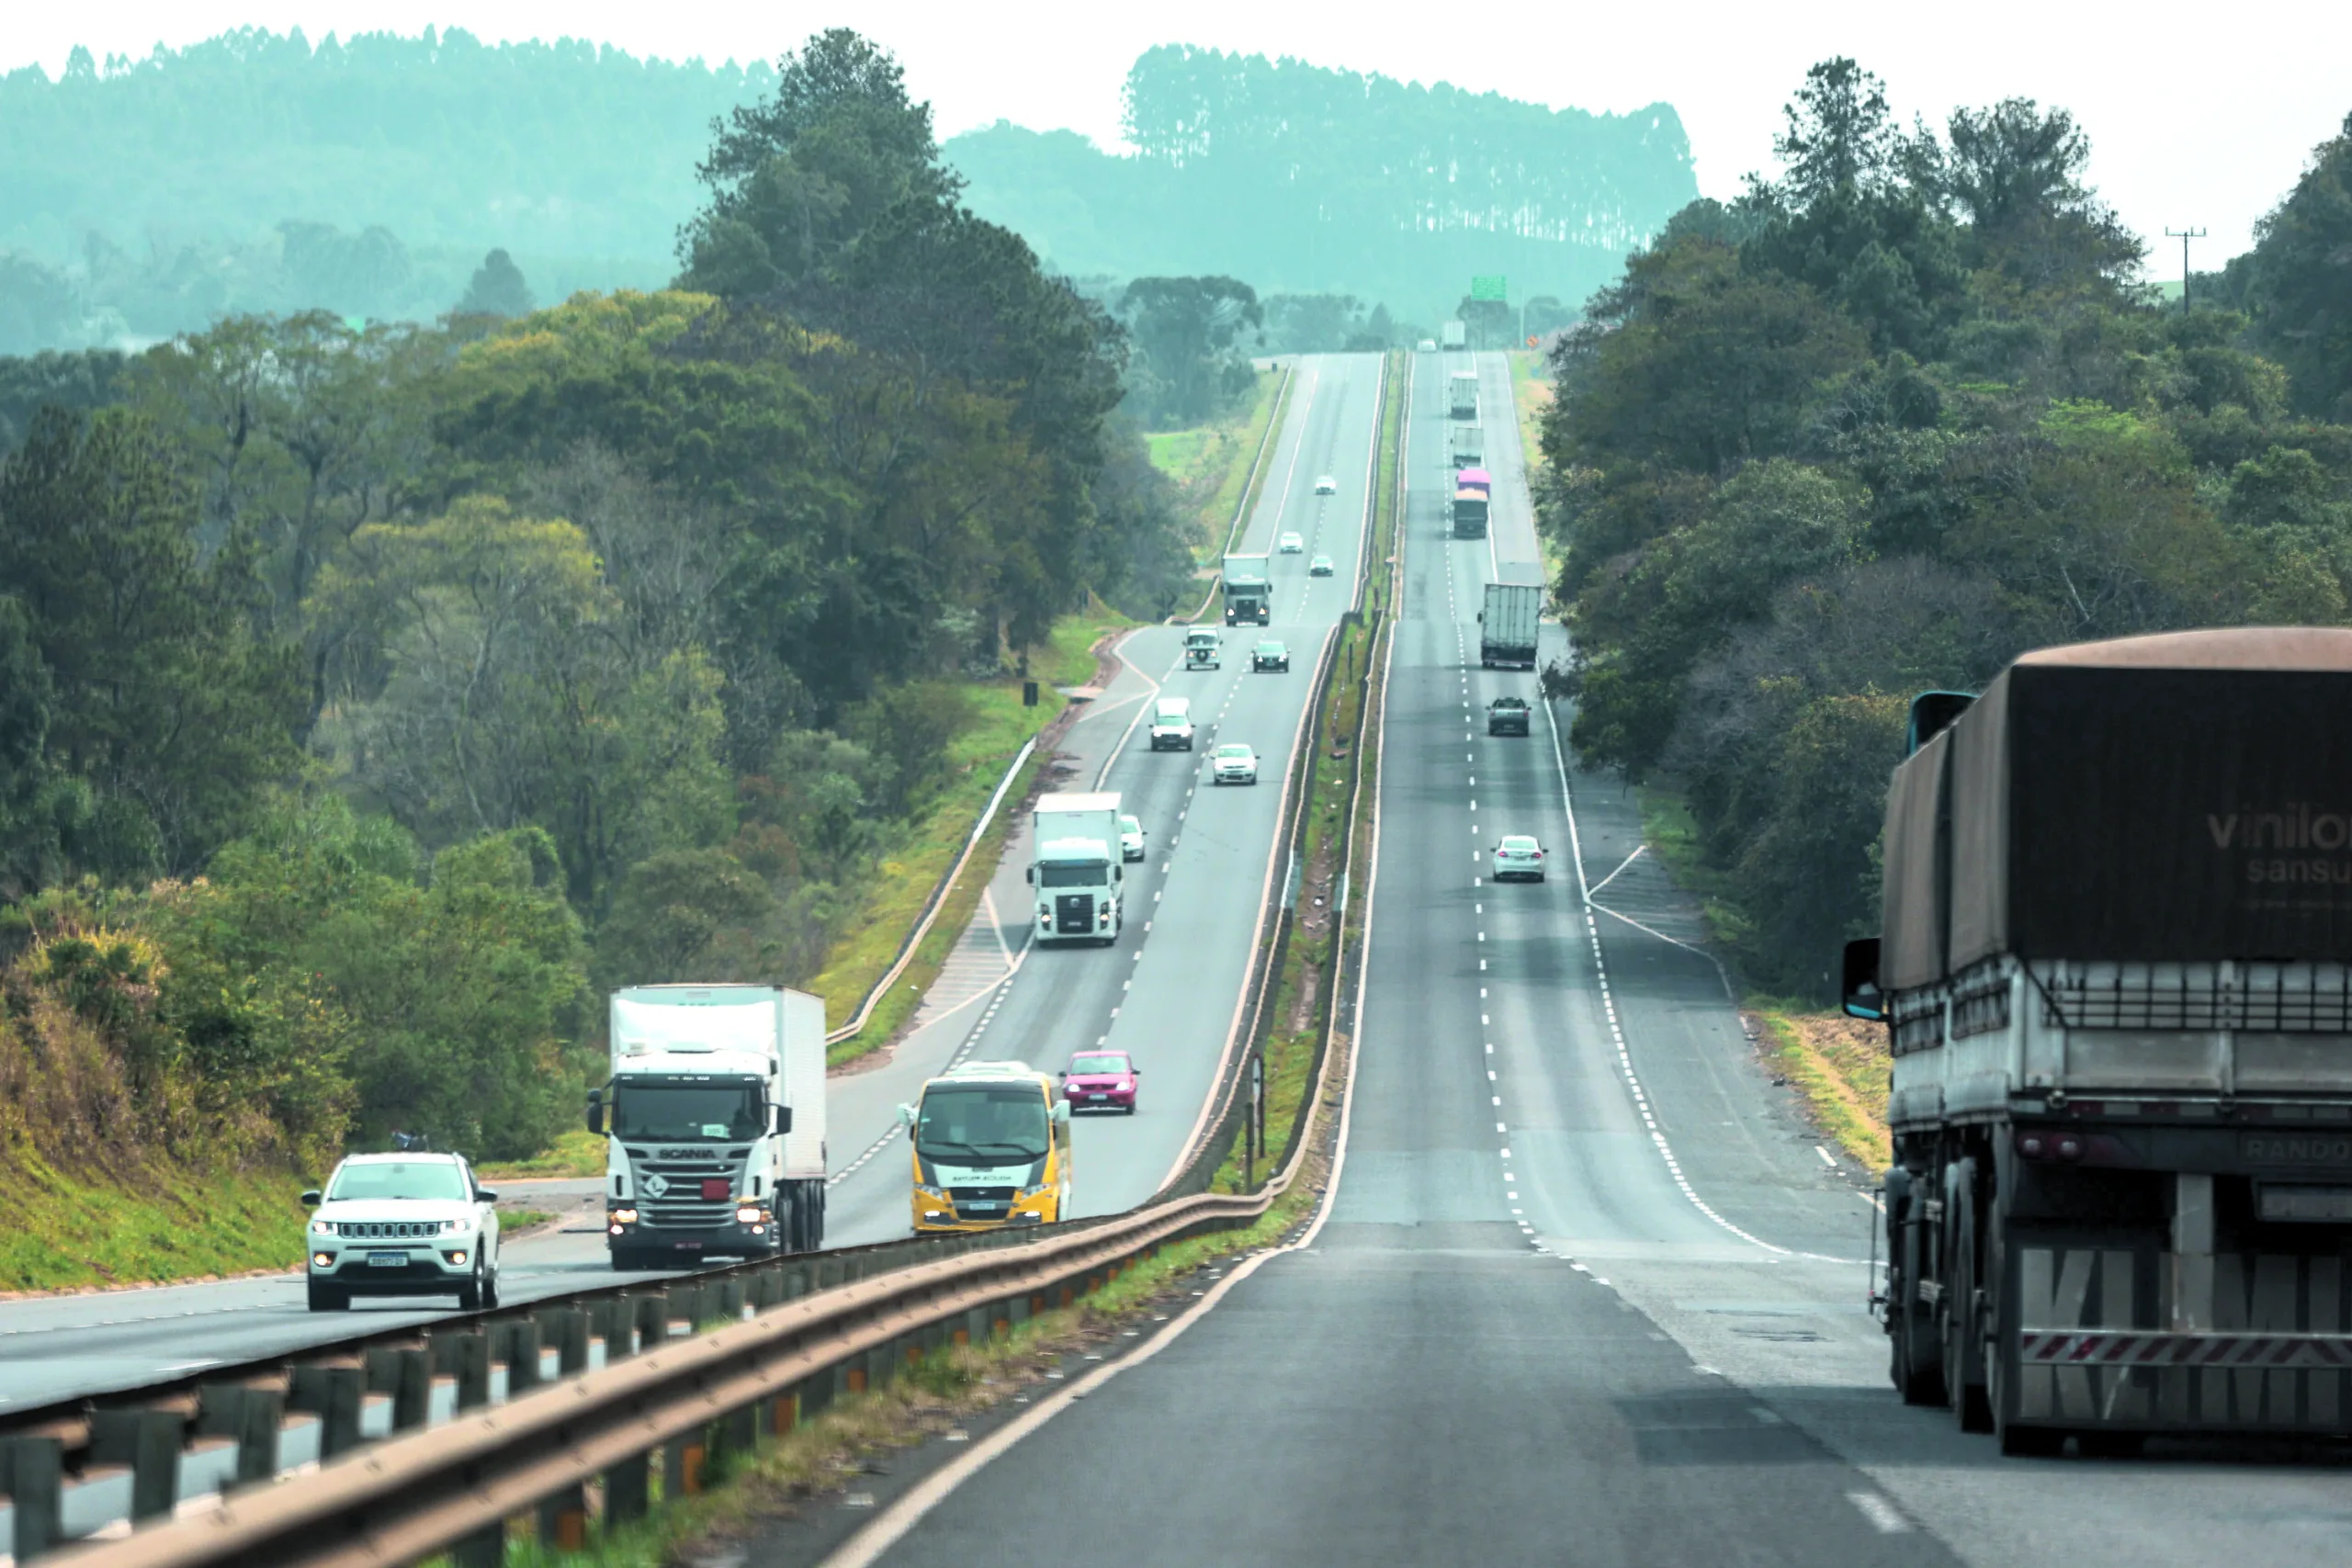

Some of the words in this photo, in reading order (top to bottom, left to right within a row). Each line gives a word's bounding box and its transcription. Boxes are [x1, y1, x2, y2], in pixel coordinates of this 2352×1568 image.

[2205, 801, 2352, 851] vinilo
[2246, 858, 2352, 885] sansu
[659, 1148, 717, 1159] SCANIA
[2245, 1139, 2350, 1160] RANDO
